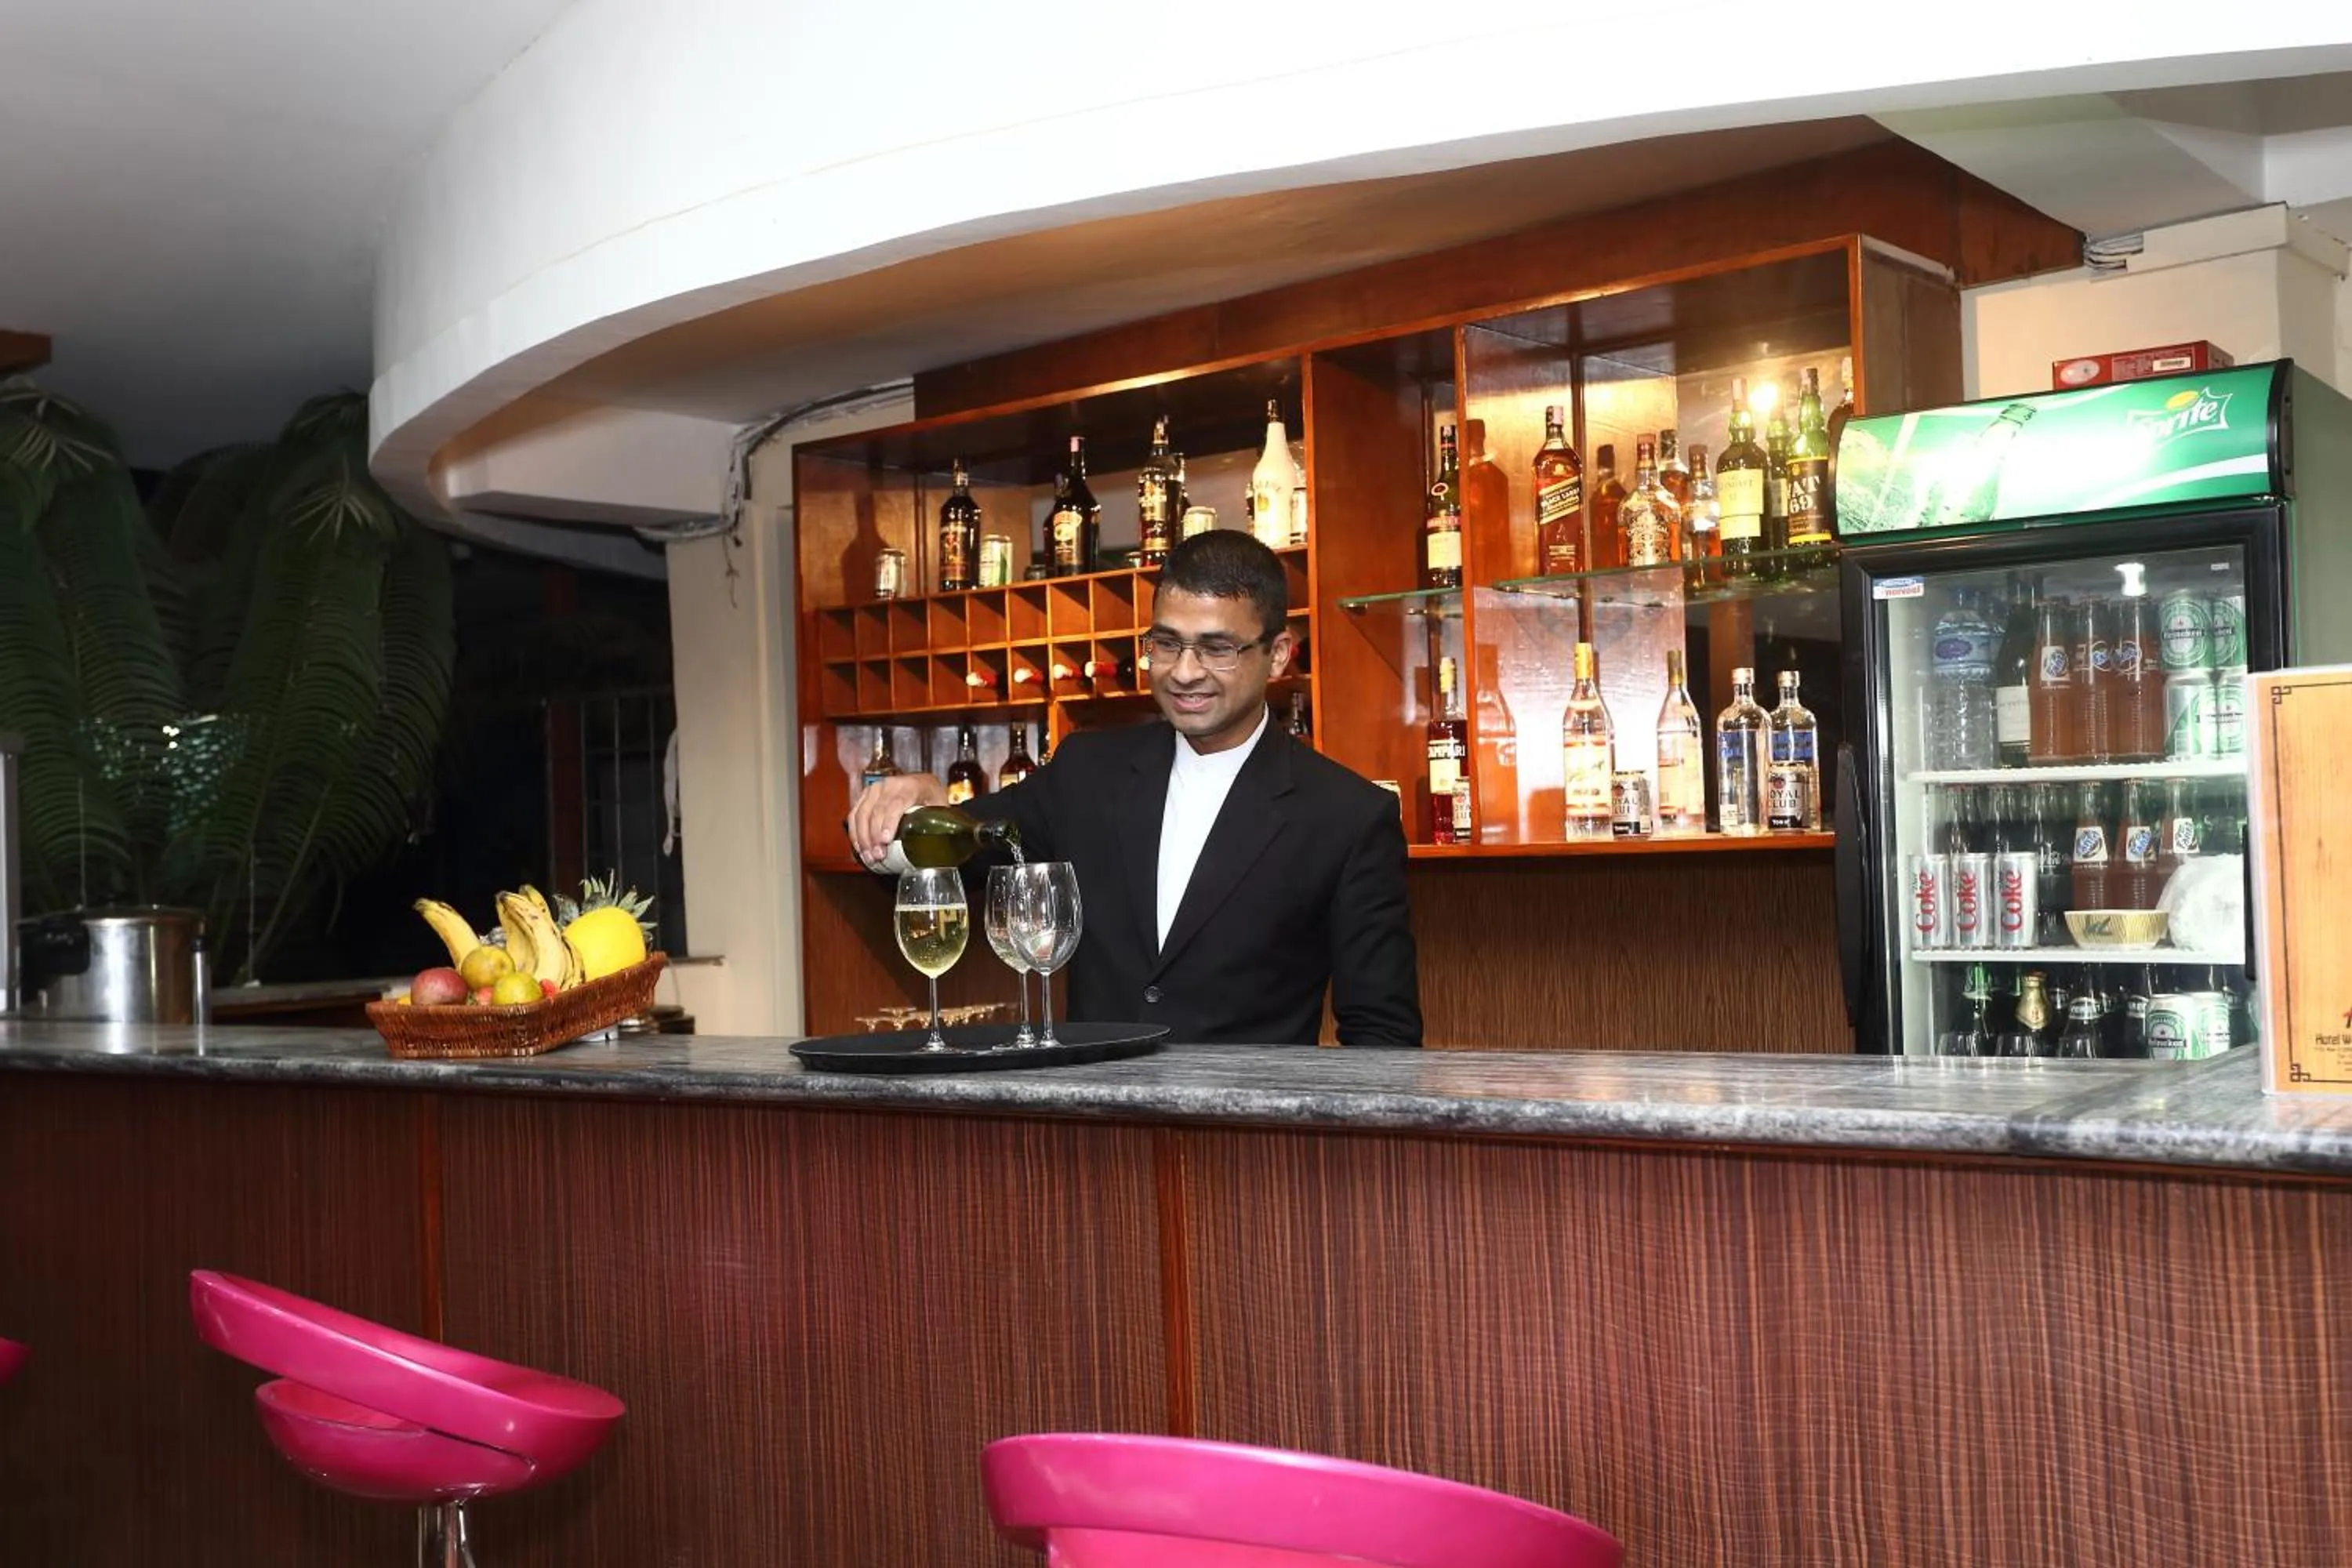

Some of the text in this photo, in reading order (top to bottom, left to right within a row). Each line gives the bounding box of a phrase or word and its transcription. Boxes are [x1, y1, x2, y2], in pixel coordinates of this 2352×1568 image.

[2134, 397, 2218, 437] Sprite
[1428, 744, 1465, 758] AMPARI
[1612, 797, 1638, 805] OYAL
[1769, 789, 1800, 799] OYAL
[1916, 870, 1936, 932] Coke
[1957, 871, 1976, 931] Coke
[2001, 870, 2021, 931] Coke
